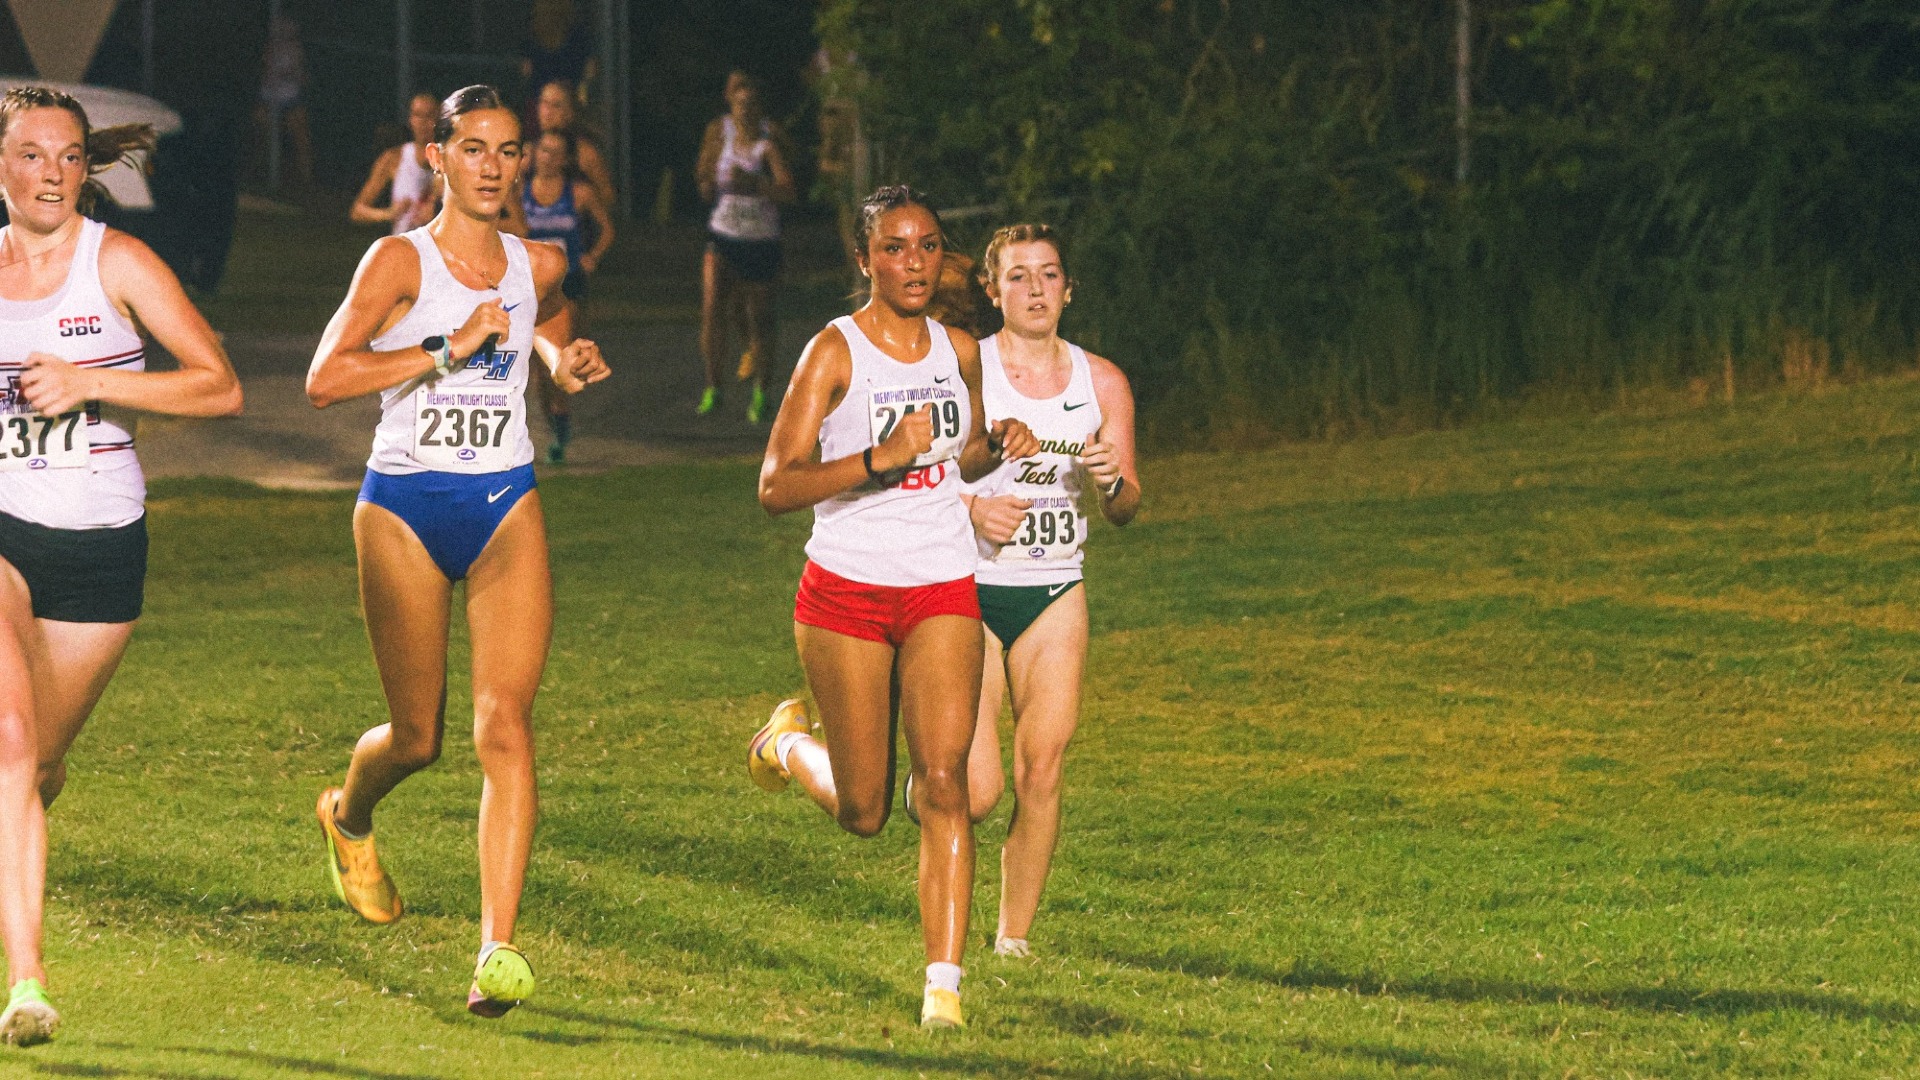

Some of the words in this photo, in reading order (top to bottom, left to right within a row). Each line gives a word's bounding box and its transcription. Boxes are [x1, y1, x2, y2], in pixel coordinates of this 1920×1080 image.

[59, 316, 102, 337] SBC
[426, 393, 455, 406] MEMPHIS
[457, 393, 483, 406] TWILIGHT
[484, 394, 508, 407] CLASSIC
[873, 390, 906, 404] MEMPHIS
[906, 387, 933, 401] TWILIGHT
[420, 408, 512, 448] 2367
[900, 462, 946, 490] BU
[1014, 461, 1058, 485] Tech
[1004, 511, 1075, 547] 393
